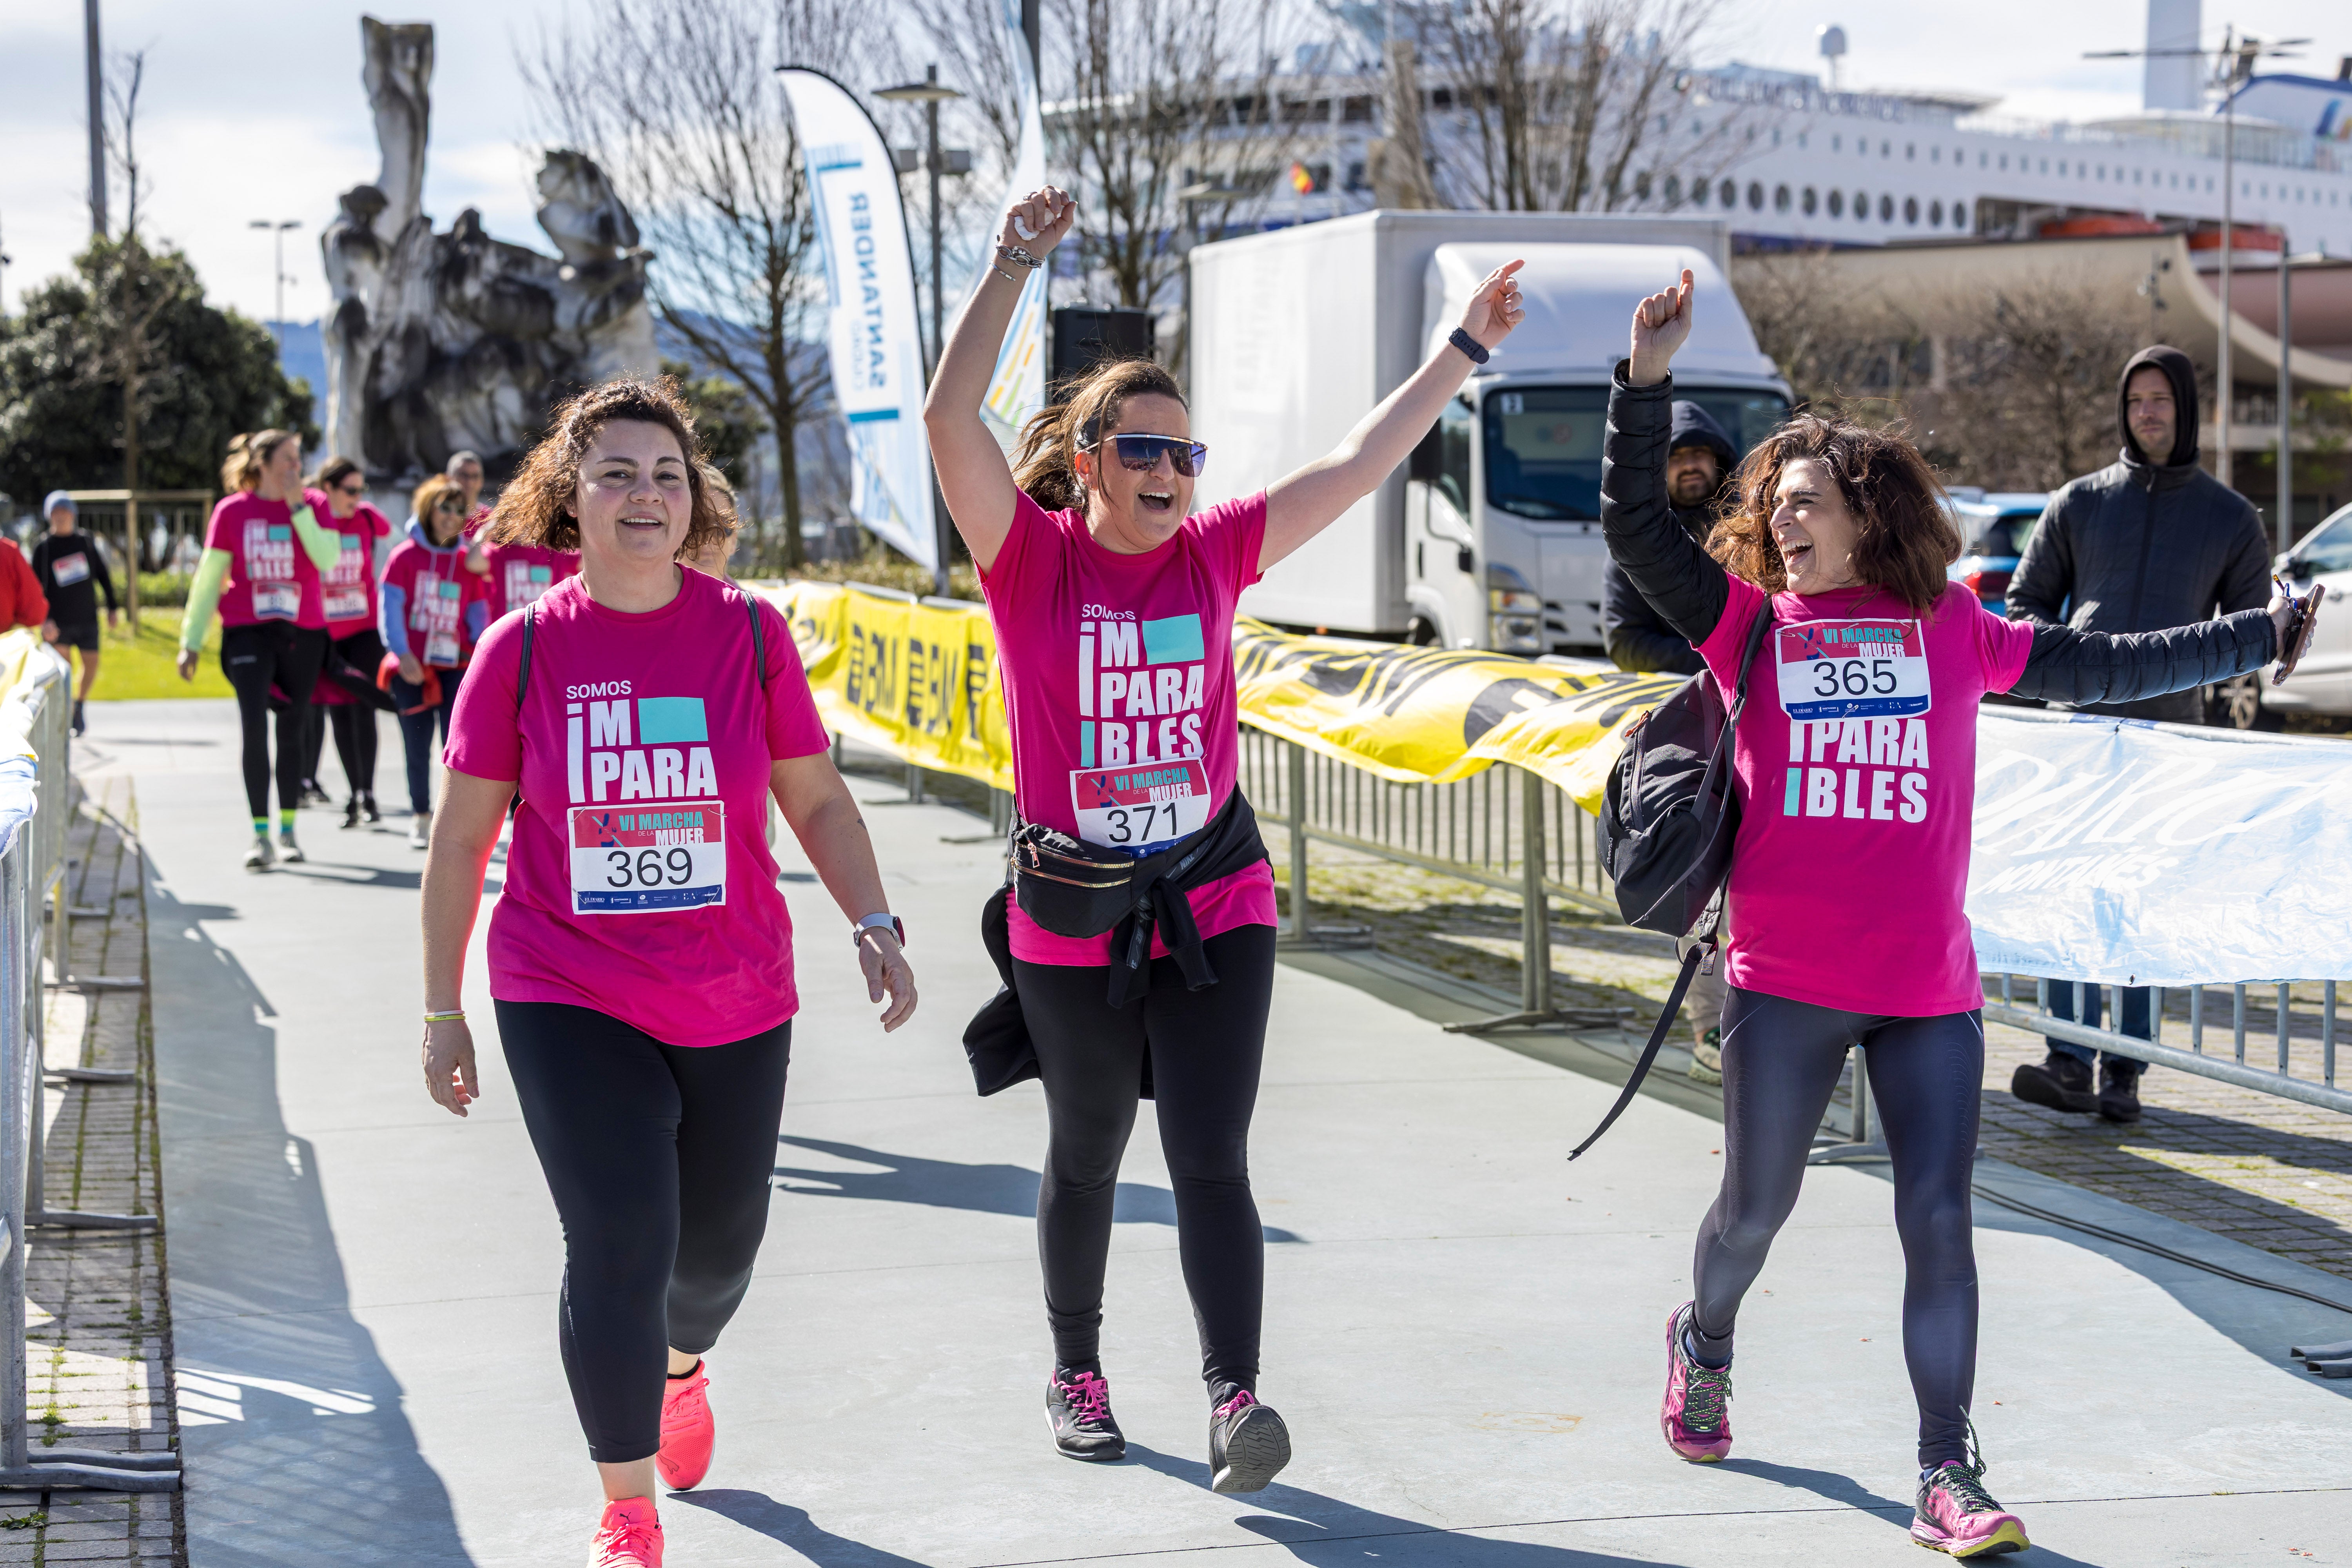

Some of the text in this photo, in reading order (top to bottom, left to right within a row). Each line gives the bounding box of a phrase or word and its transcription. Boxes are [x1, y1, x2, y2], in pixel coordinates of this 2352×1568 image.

[1082, 604, 1136, 621] SOMOS
[1822, 628, 1904, 643] VI MARCHA
[1858, 642, 1906, 658] MUJER
[1813, 660, 1897, 697] 365
[566, 680, 632, 699] SOMOS
[591, 747, 718, 802] PARA
[1114, 767, 1191, 791] VI MARCHA
[1149, 782, 1192, 802] MUJER
[619, 811, 704, 831] VI MARCHA
[1107, 802, 1177, 843] 371
[655, 828, 704, 846] MUJER
[607, 848, 693, 887] 369
[1179, 854, 1194, 870] NIKE
